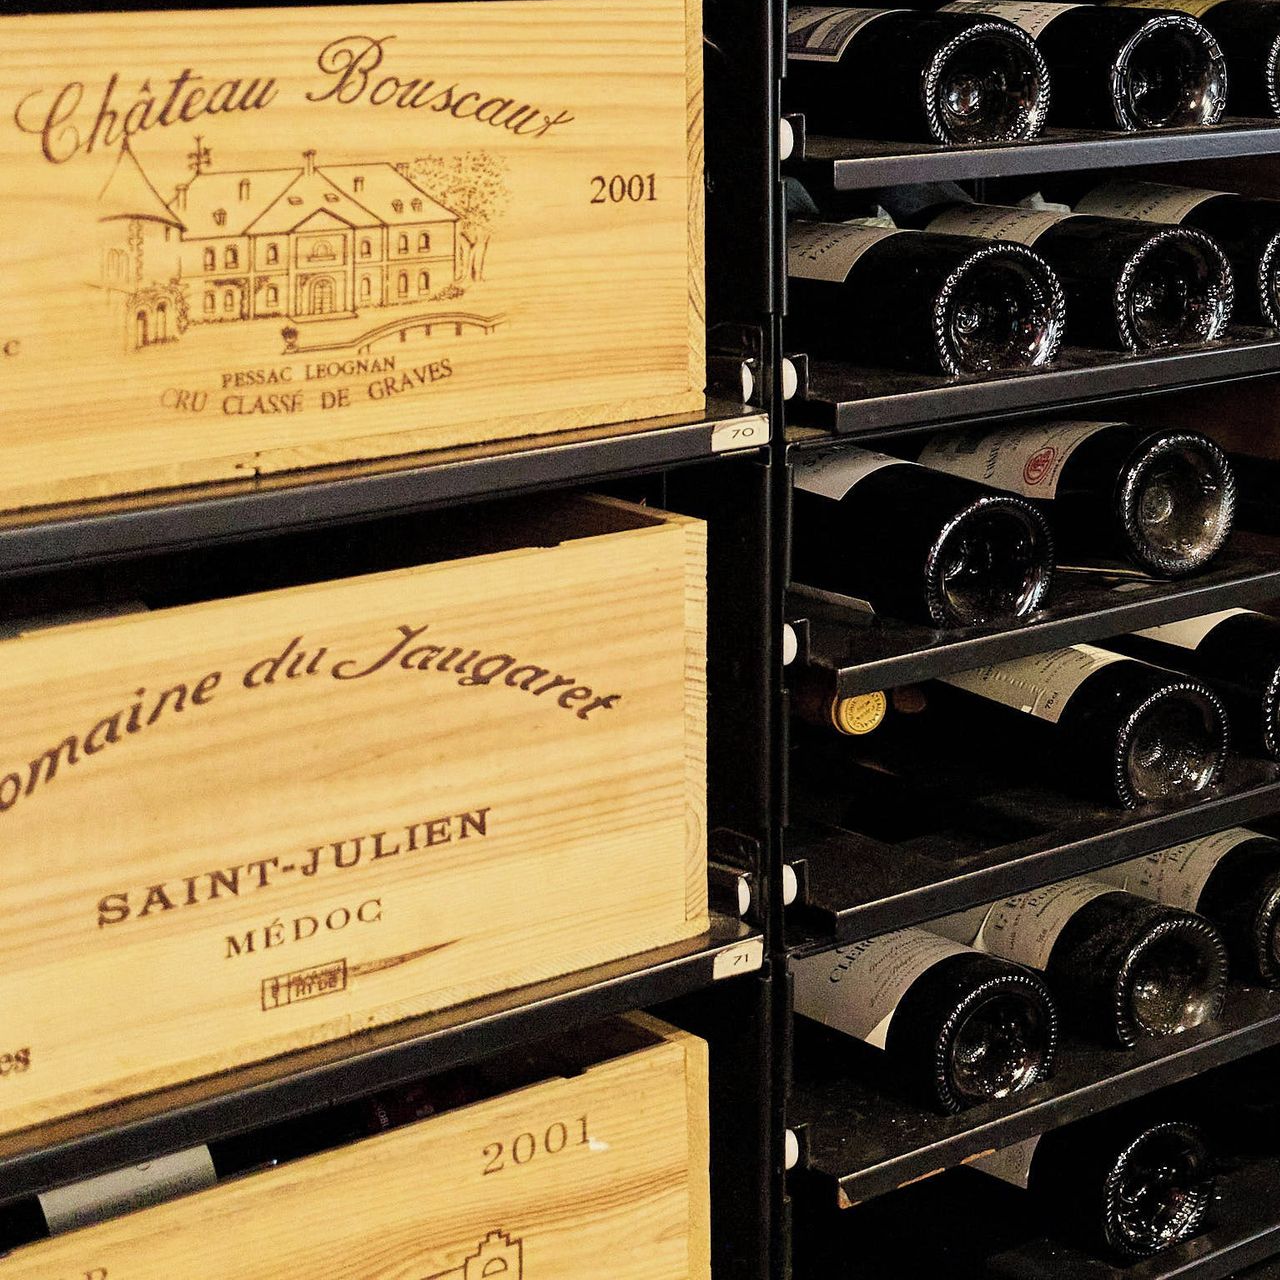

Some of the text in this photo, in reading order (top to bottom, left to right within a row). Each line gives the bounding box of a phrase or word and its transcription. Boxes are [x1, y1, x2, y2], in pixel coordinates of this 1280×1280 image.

[14, 67, 279, 164] Château
[590, 174, 659, 204] 2001
[160, 386, 207, 412] CRU
[320, 389, 351, 410] DE
[366, 358, 453, 401] GRAVES
[221, 356, 396, 390] PESSAC LEOGNAN
[731, 427, 754, 440] 70
[242, 635, 328, 690] du
[331, 624, 622, 721] Jaugaret
[97, 807, 492, 929] SAINT-JULIEN
[225, 898, 382, 957] MÉDOC
[733, 953, 749, 966] 71
[482, 1115, 595, 1175] 2001
